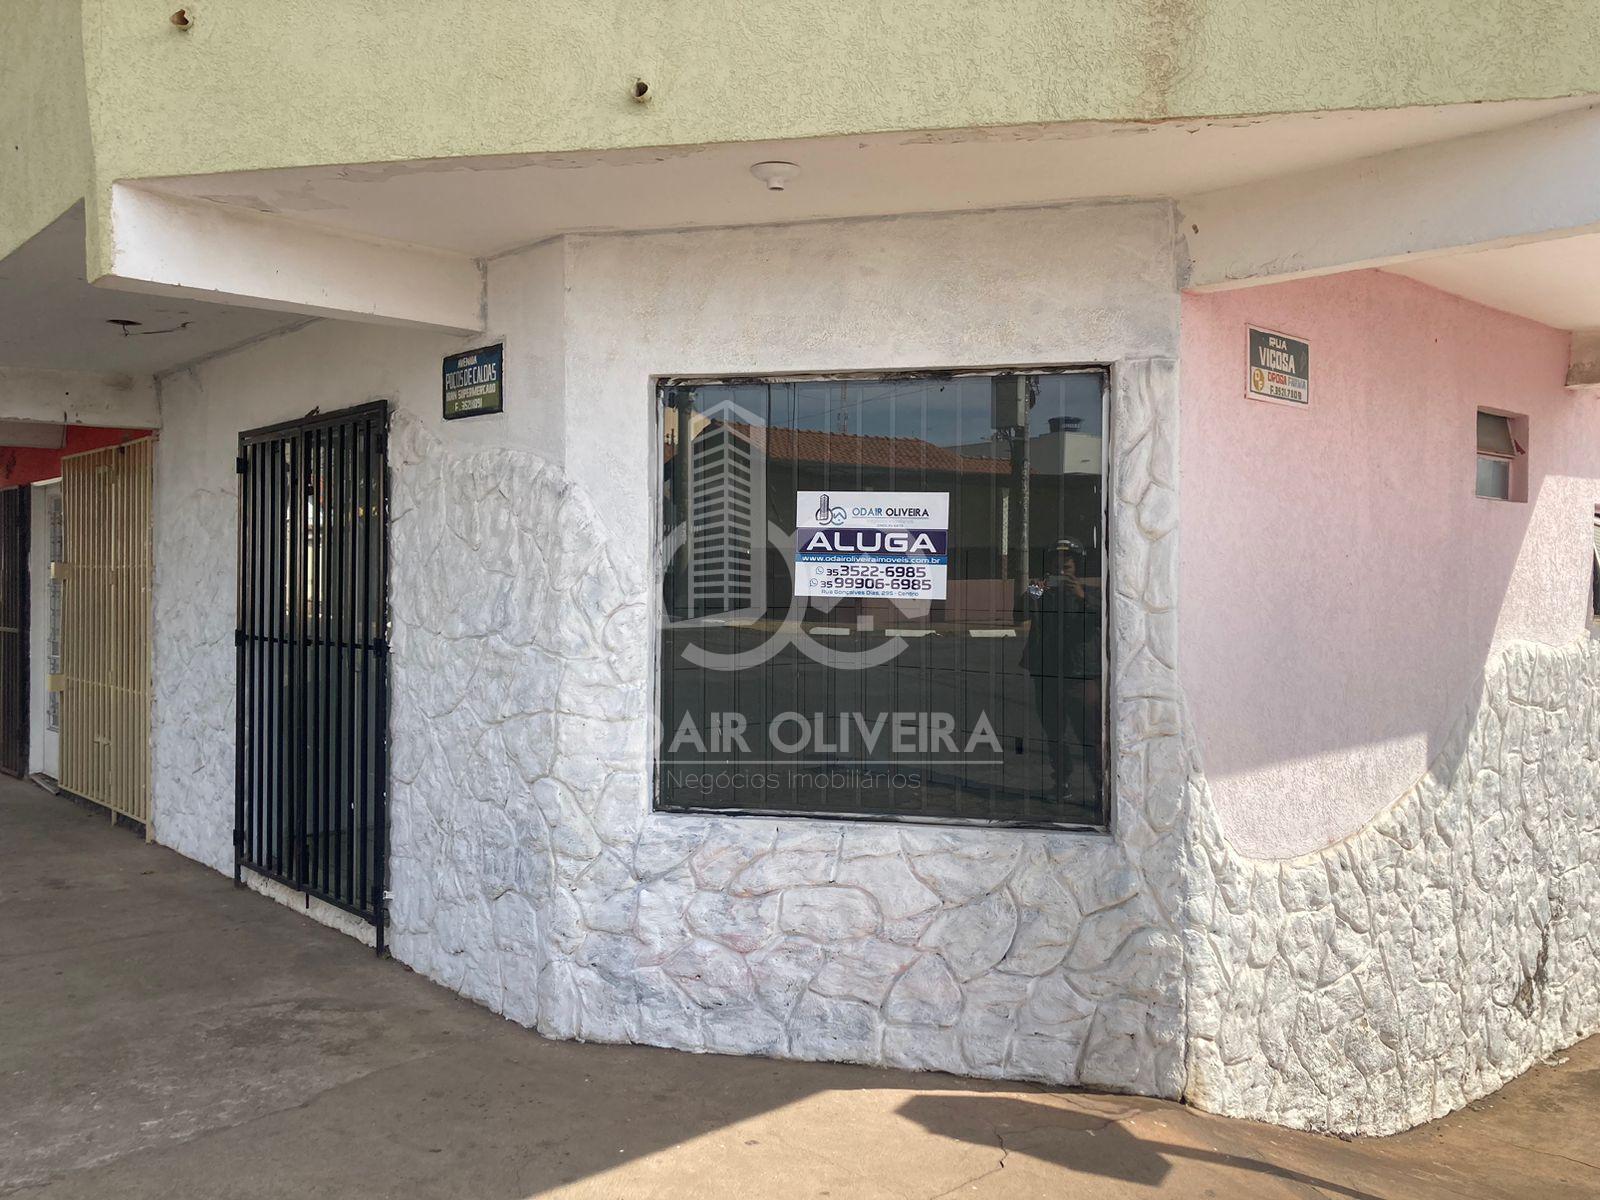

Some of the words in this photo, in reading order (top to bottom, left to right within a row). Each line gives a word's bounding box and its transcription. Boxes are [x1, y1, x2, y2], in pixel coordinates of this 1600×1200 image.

[1269, 337, 1287, 350] RUA
[1259, 346, 1295, 373] VIÇOSA
[464, 367, 472, 386] DE
[473, 363, 496, 383] CALDAS
[852, 506, 883, 517] ODAIR
[885, 506, 930, 518] OLIVEIRA
[806, 531, 937, 553] ALUGA
[802, 555, 941, 565] www.odairoliveiraimoveis.com.br
[826, 568, 839, 577] 35
[840, 565, 927, 578] 3522-6985
[820, 580, 833, 589] 35
[834, 577, 932, 591] 99906-6985
